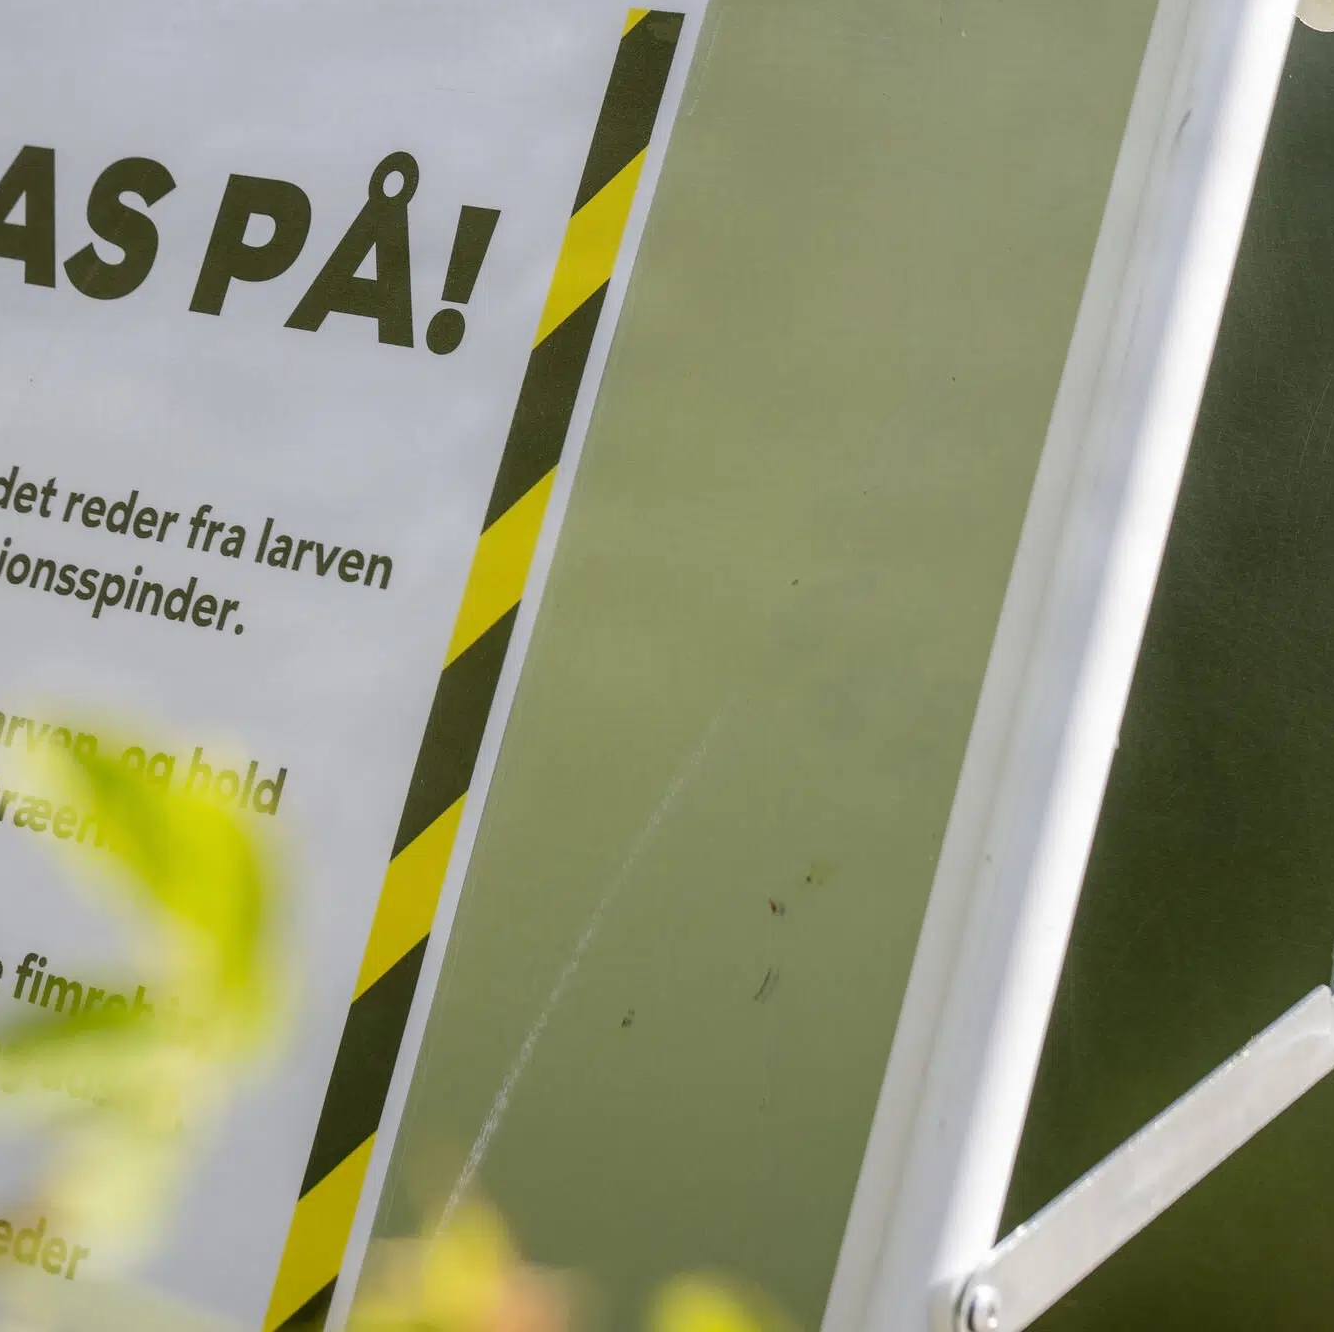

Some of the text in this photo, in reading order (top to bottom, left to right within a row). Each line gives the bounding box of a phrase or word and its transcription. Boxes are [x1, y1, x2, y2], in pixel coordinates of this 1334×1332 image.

[189, 150, 502, 356] PÅ!
[62, 489, 180, 543] reder
[186, 504, 247, 560] fra
[254, 516, 394, 591] larven
[182, 746, 288, 816] hold
